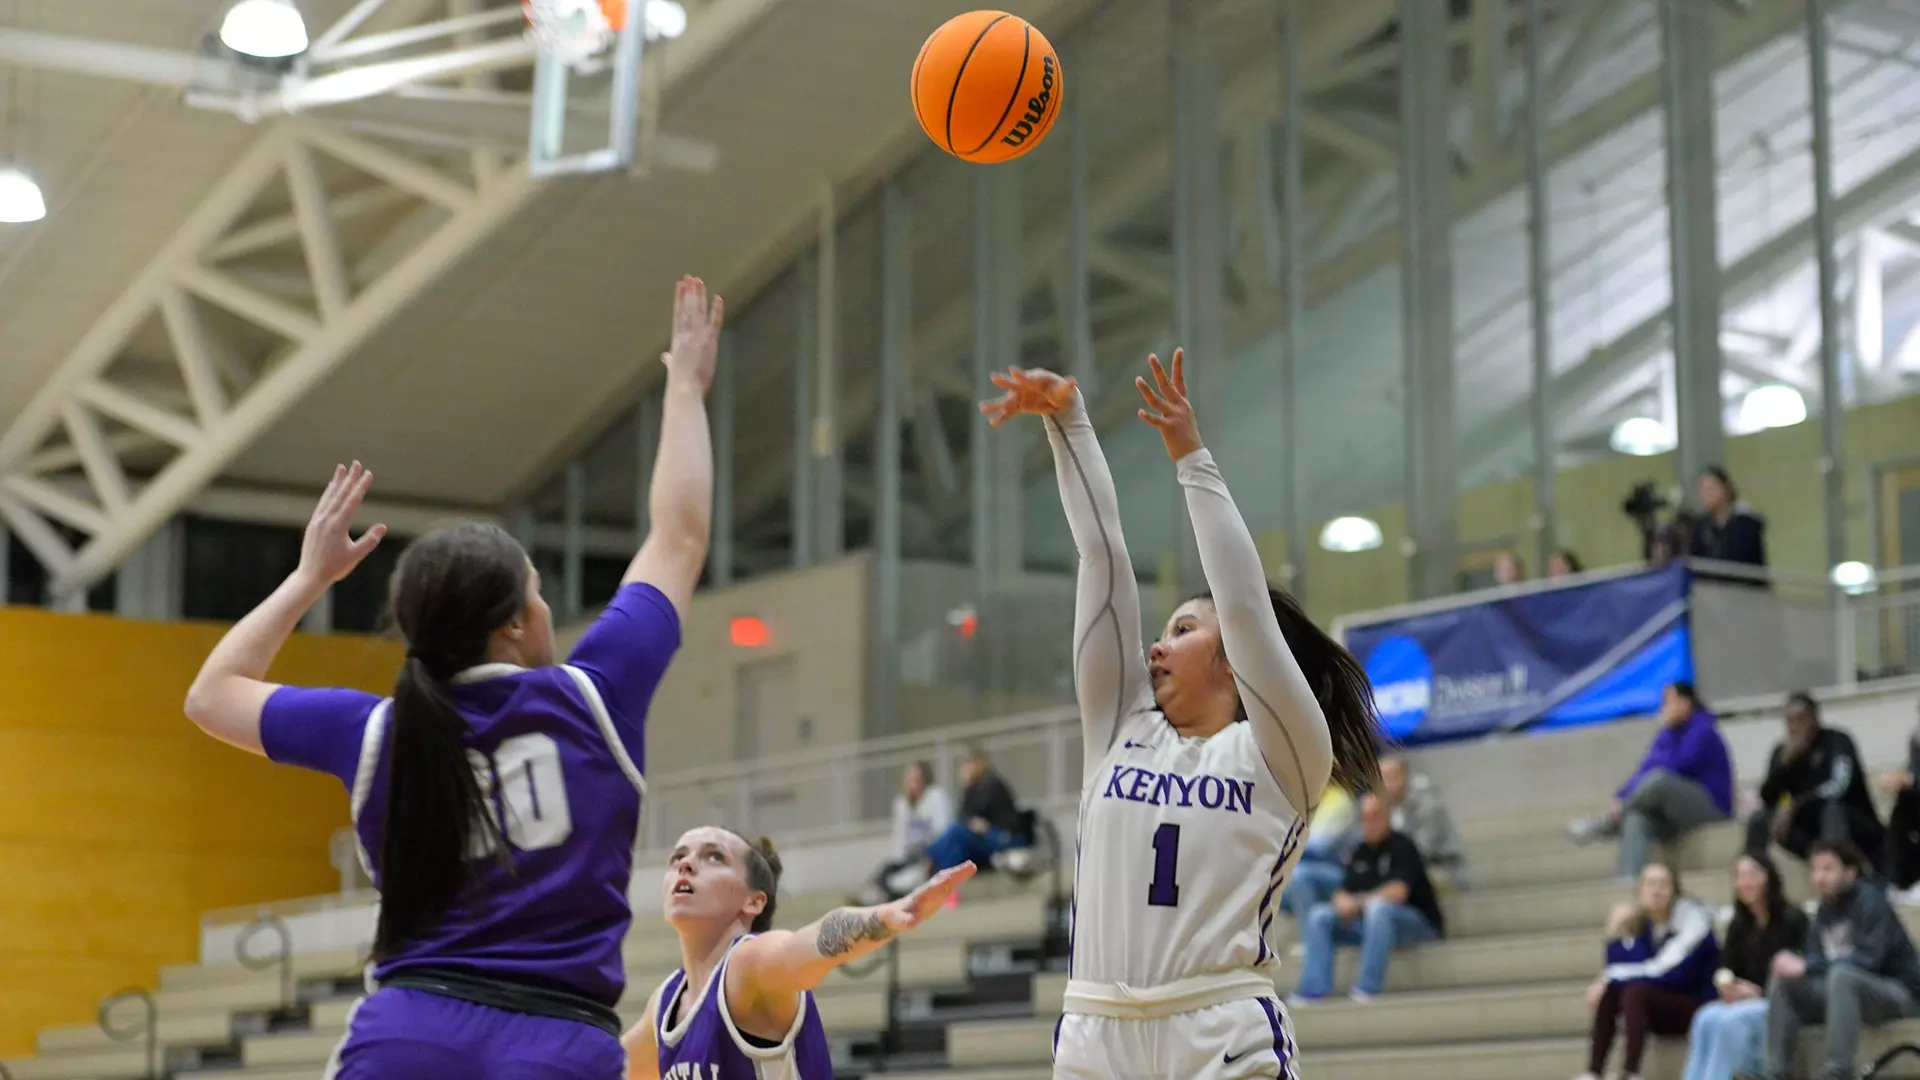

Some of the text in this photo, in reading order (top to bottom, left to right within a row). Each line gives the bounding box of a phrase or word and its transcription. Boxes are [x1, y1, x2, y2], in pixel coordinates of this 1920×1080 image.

[1001, 55, 1054, 147] Wilson
[1103, 765, 1256, 815] KENYON
[1148, 823, 1180, 907] 1
